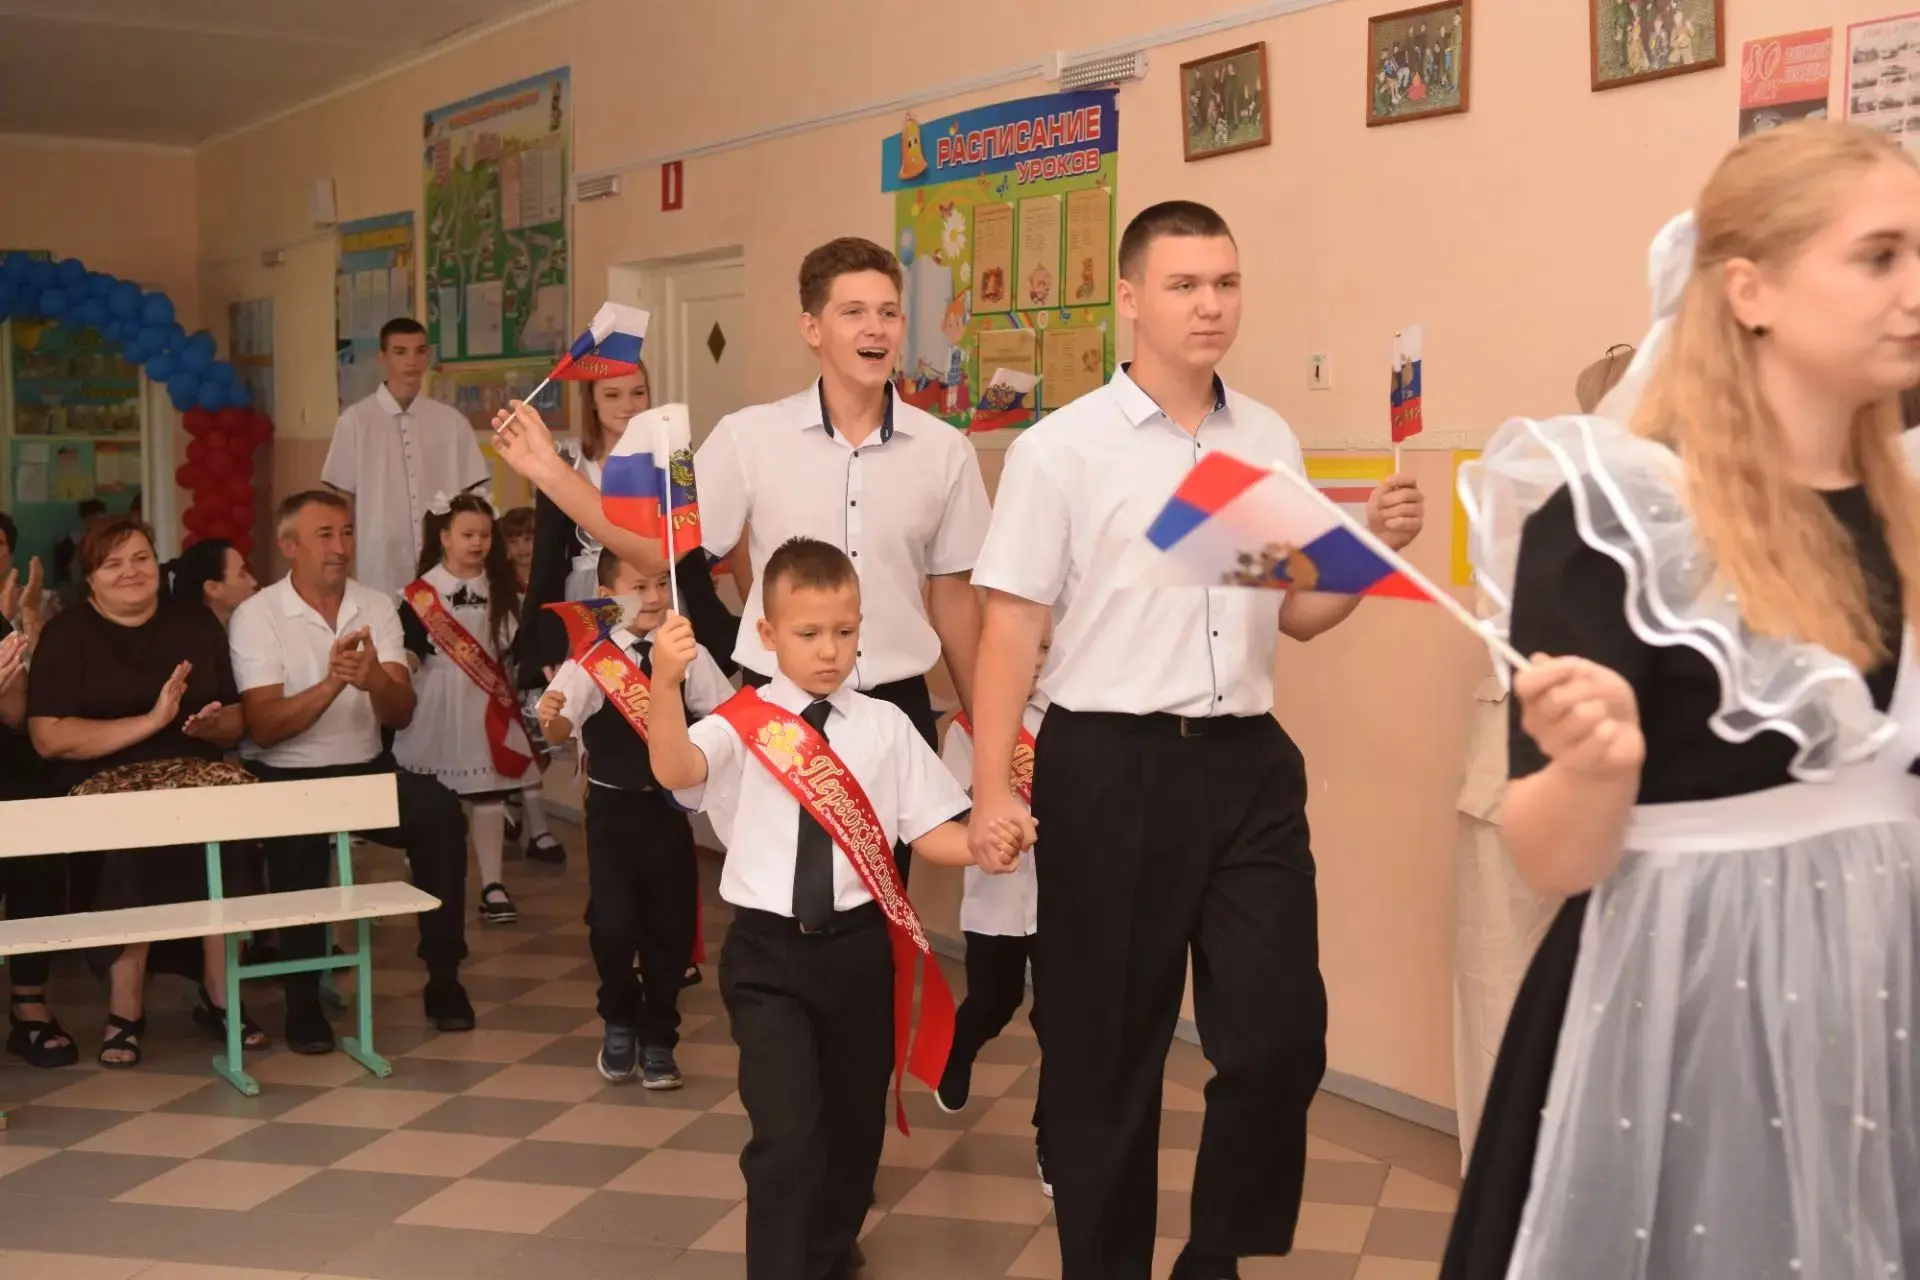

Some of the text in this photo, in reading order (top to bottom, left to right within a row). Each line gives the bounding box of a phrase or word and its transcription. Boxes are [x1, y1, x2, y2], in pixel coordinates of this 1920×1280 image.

[936, 104, 1102, 170] РАСПИСАНИЕ
[1015, 147, 1101, 185] УРОКОВ
[797, 754, 903, 924] Первоклассник
